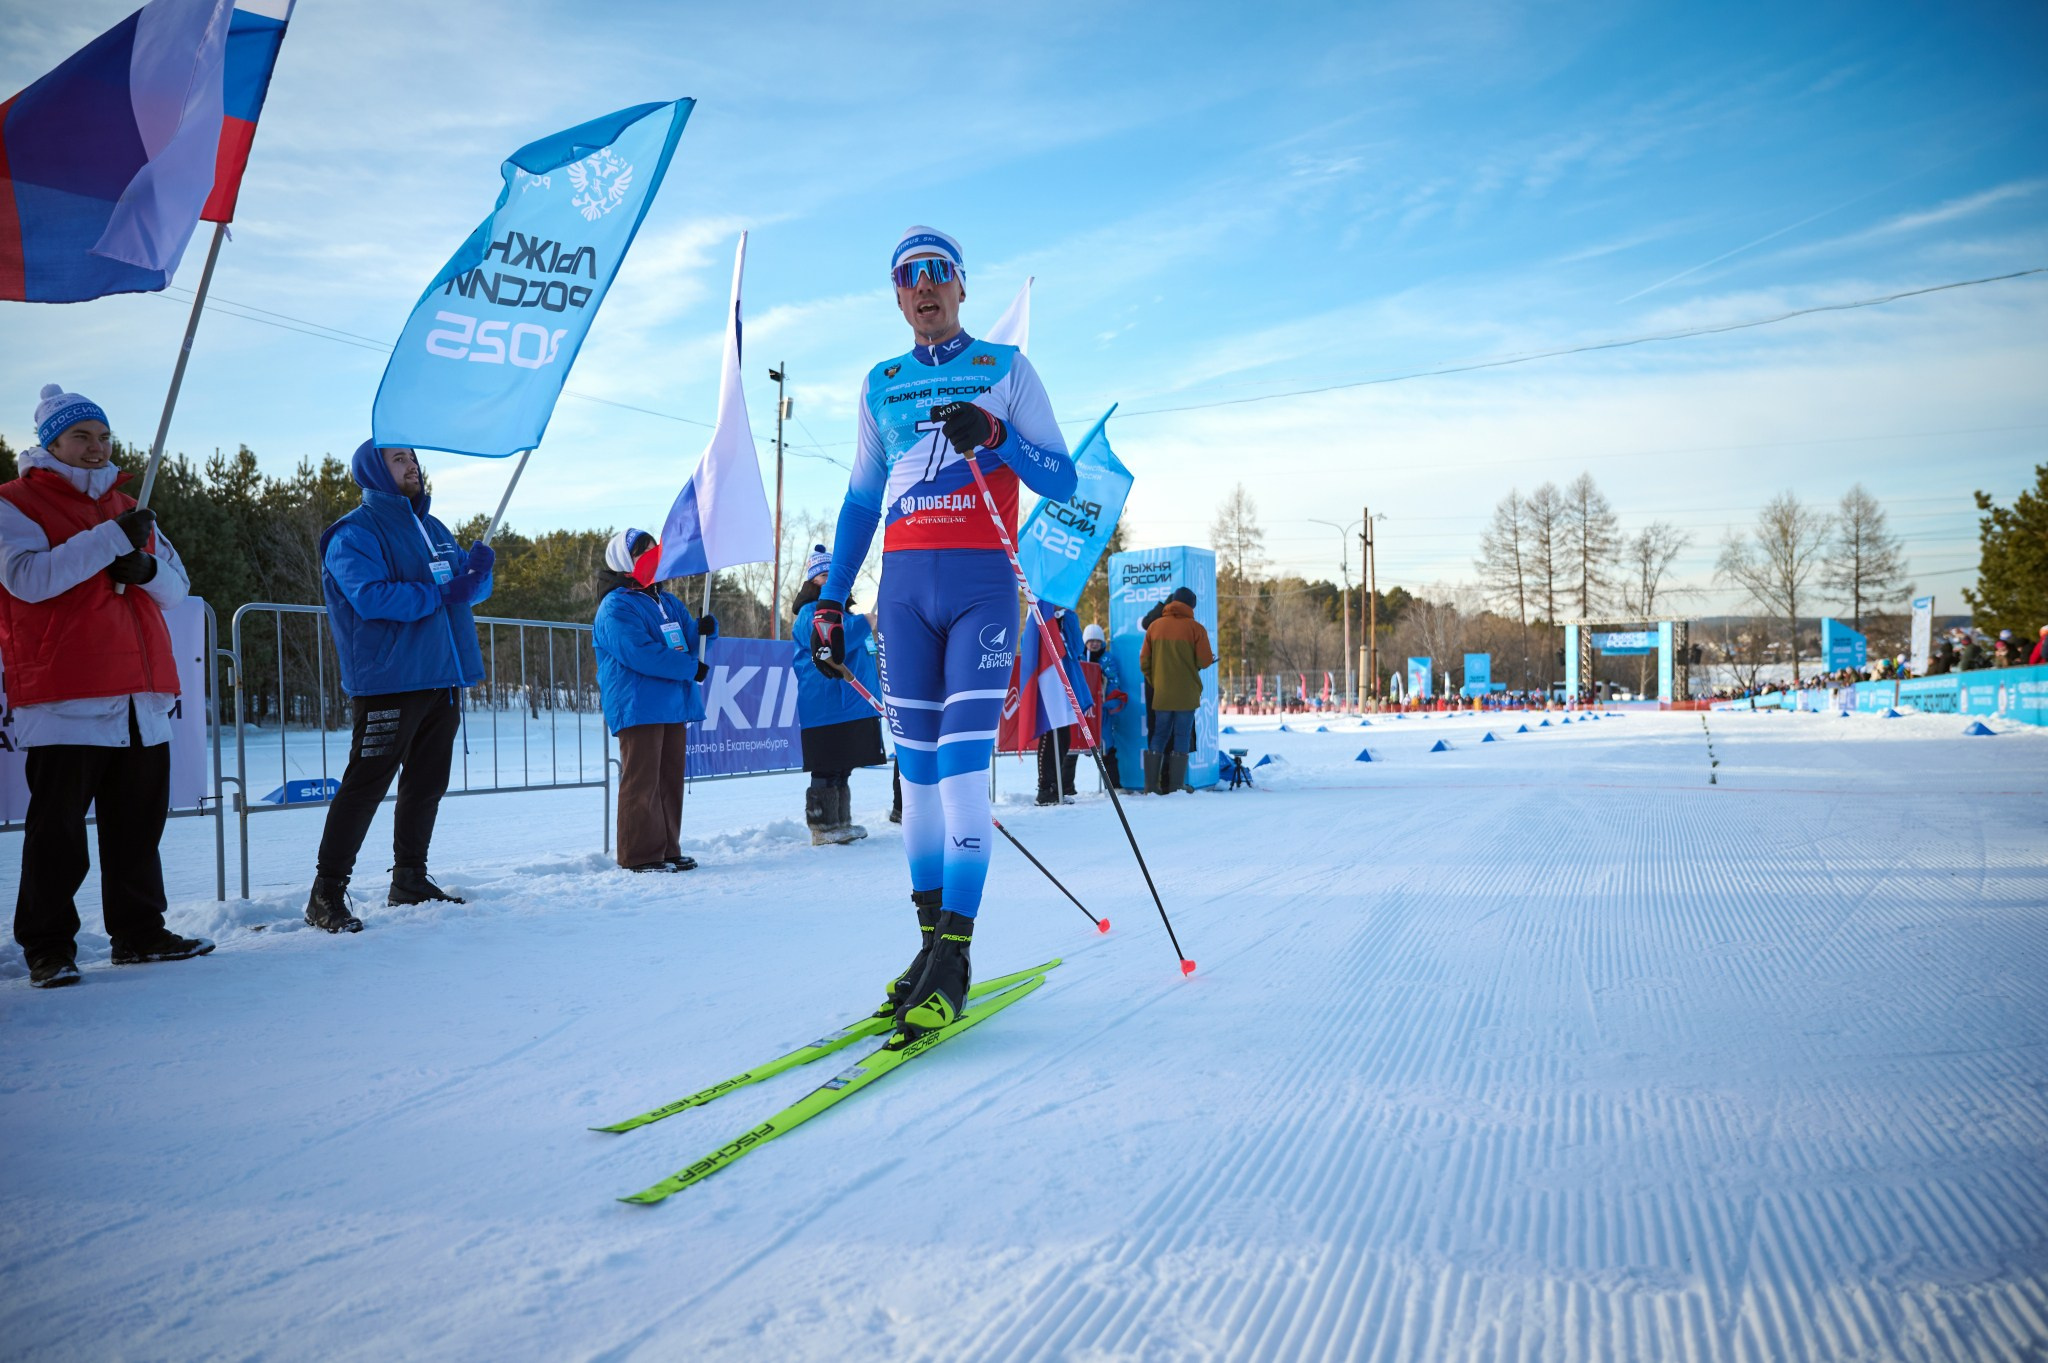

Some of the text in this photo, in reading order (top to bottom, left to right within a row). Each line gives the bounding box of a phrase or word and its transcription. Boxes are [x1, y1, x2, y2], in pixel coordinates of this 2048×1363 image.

[883, 385, 992, 406] ЛЫЖНЯ РОССИИ
[50, 405, 102, 429] РОССИИ
[915, 420, 951, 482] 7
[917, 494, 976, 511] ПОБЕДА!
[1045, 500, 1096, 538] ССИИ
[1027, 517, 1085, 560] 025
[1122, 561, 1171, 575] ЛЫЖНЯ
[1122, 573, 1172, 586] РОССИИ
[981, 651, 1012, 662] ВСМПО
[686, 738, 789, 755] делано в Екатеринбурге
[901, 1032, 940, 1060] FISCHER
[672, 1123, 775, 1182] FISCHER
